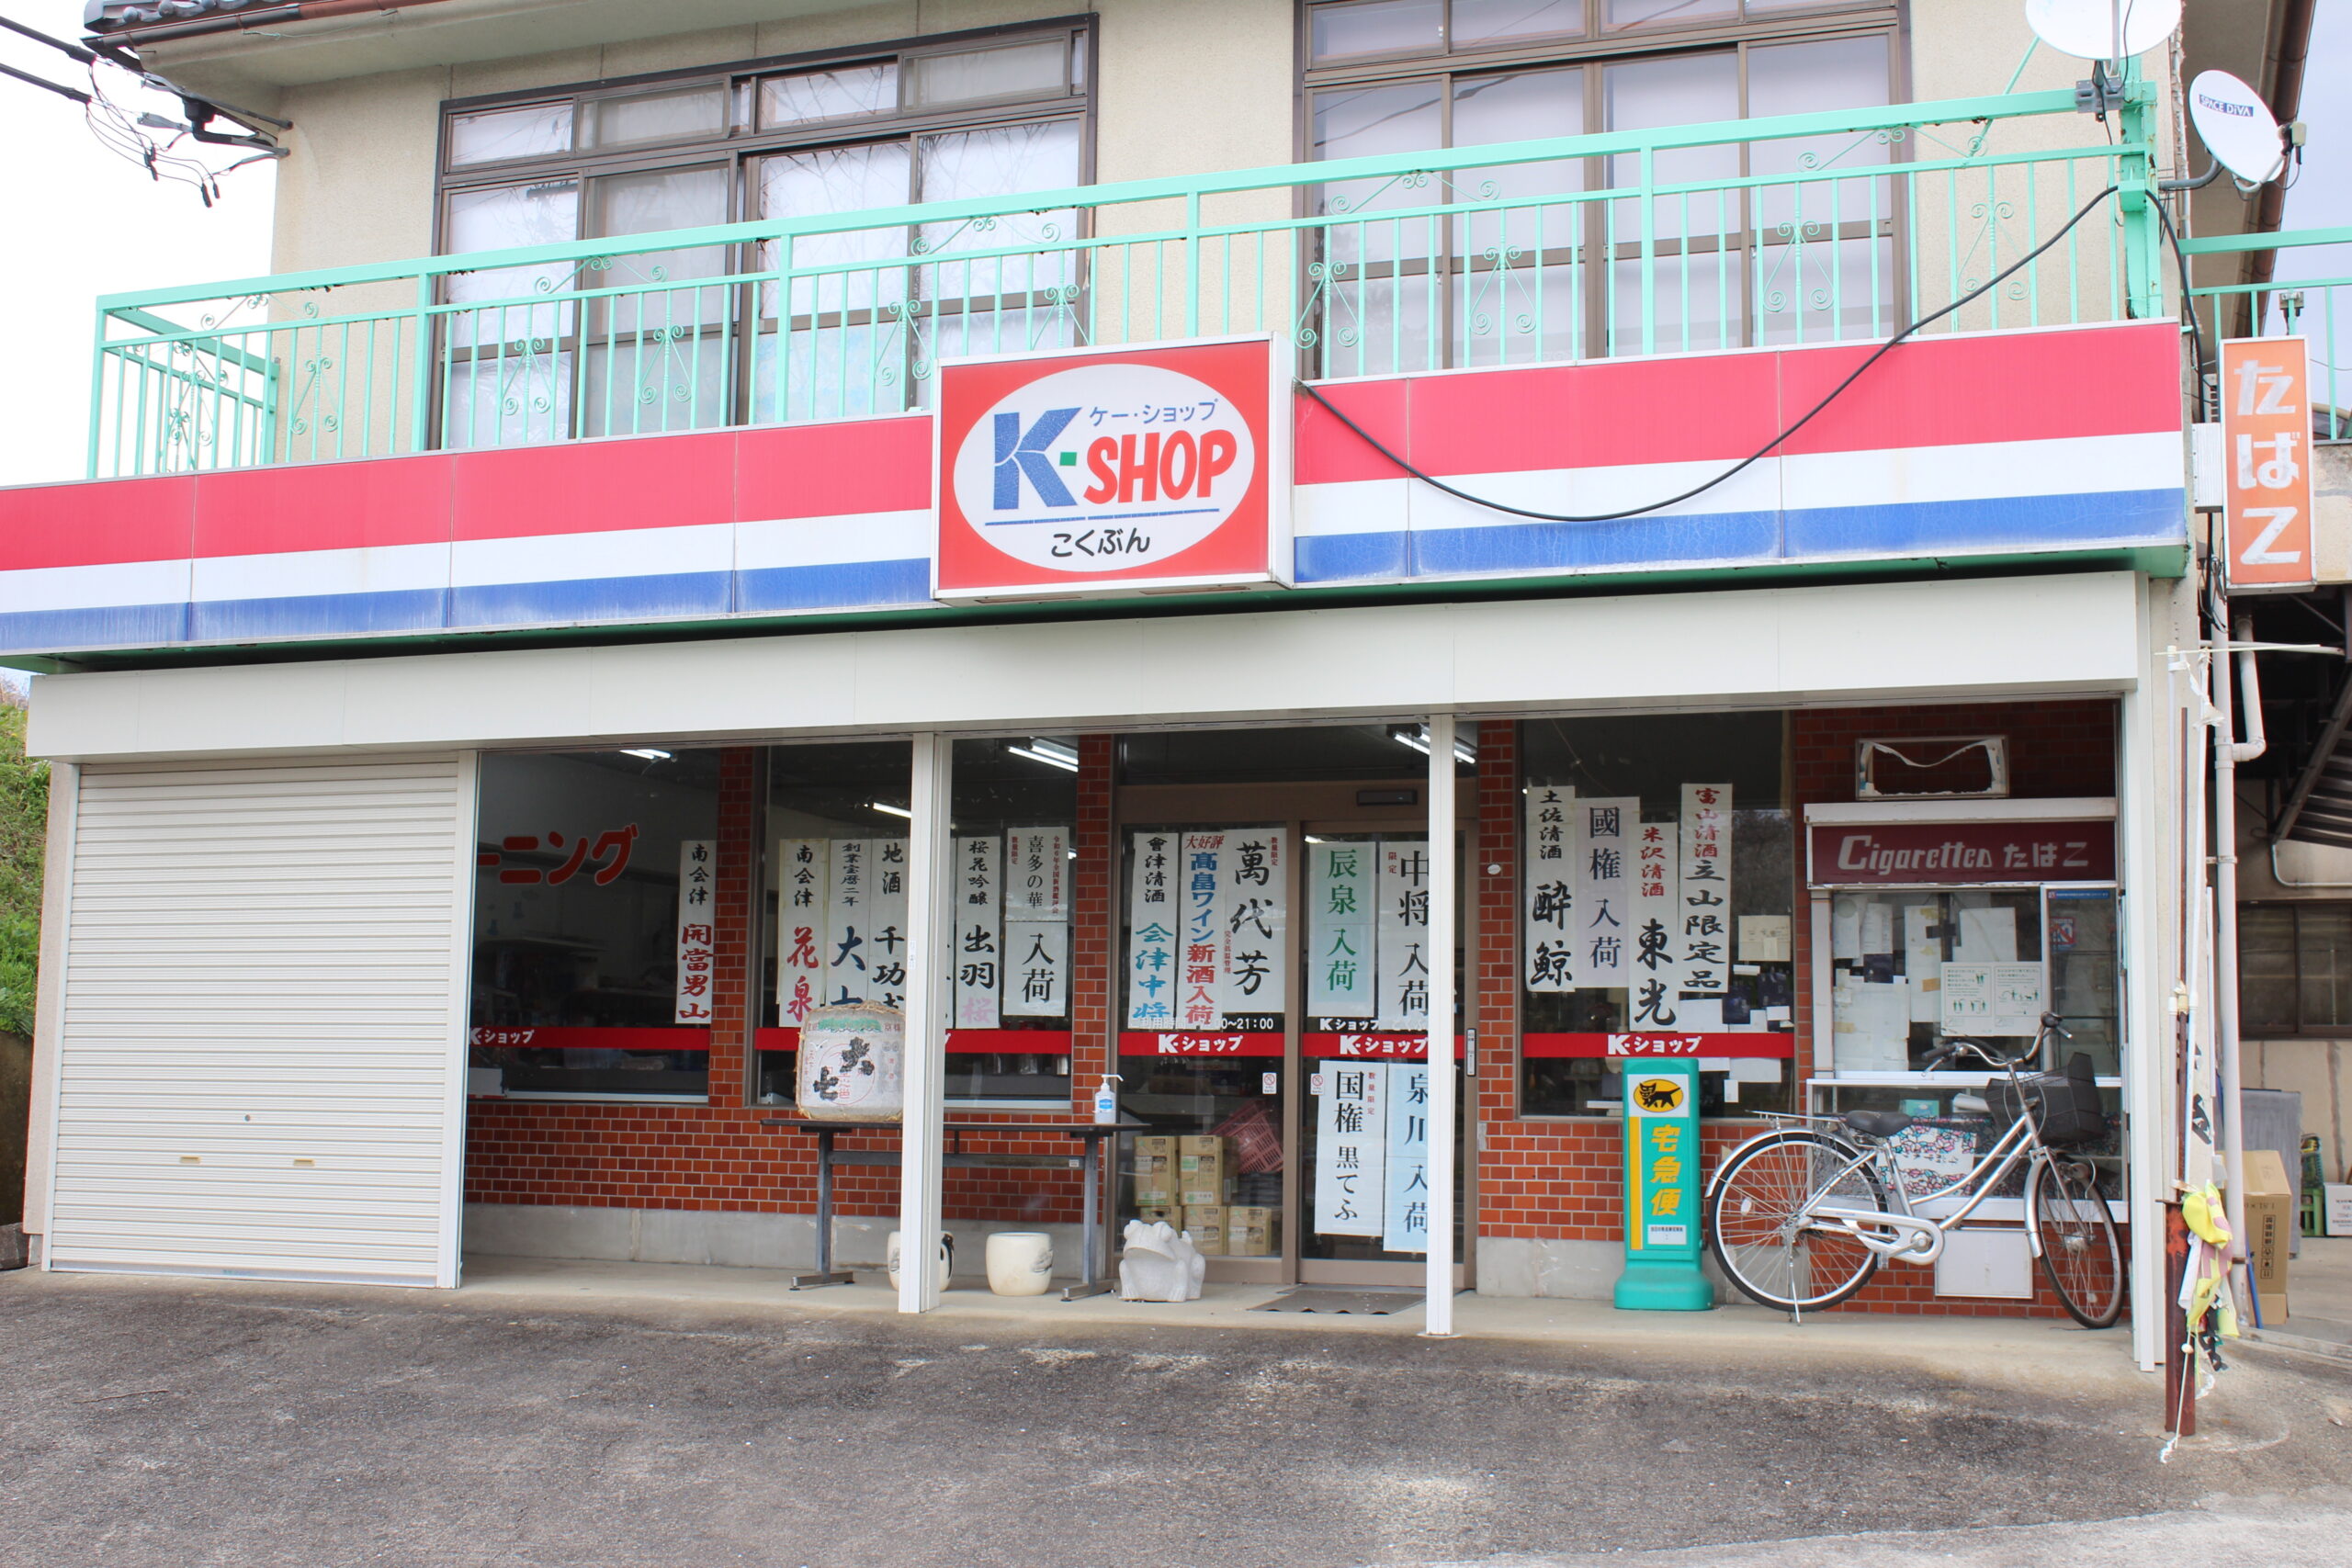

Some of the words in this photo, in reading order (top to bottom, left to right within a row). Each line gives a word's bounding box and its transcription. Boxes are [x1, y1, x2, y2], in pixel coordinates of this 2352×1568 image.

[2199, 95, 2224, 111] SPACE
[1089, 398, 1219, 427] ケー・ショップ
[2233, 359, 2301, 567] たばこ
[1050, 527, 1150, 558] こくぶん
[1184, 835, 1225, 849] 大好評
[1539, 790, 1564, 860] 土佐清酒
[1694, 788, 1720, 858] 富山清酒
[689, 843, 710, 906] 南会津
[793, 844, 816, 908] 南会津
[882, 842, 904, 895] 地酒
[1027, 835, 1045, 909] 喜多の華
[1327, 849, 1358, 915] 辰泉
[1640, 827, 1666, 897] 米沢清酒
[1229, 840, 1273, 996] 萬代芳
[1531, 880, 1572, 987] 酔鯨
[1589, 898, 1621, 968] 入荷
[1683, 859, 1725, 988] 立山限定品
[1022, 933, 1055, 1003] 入荷
[1326, 929, 1357, 992] 入荷
[1397, 942, 1430, 1017] 入荷
[1634, 919, 1676, 1025] 東光
[1334, 1070, 1365, 1134] 国権
[1649, 1124, 1683, 1215] 宅急便
